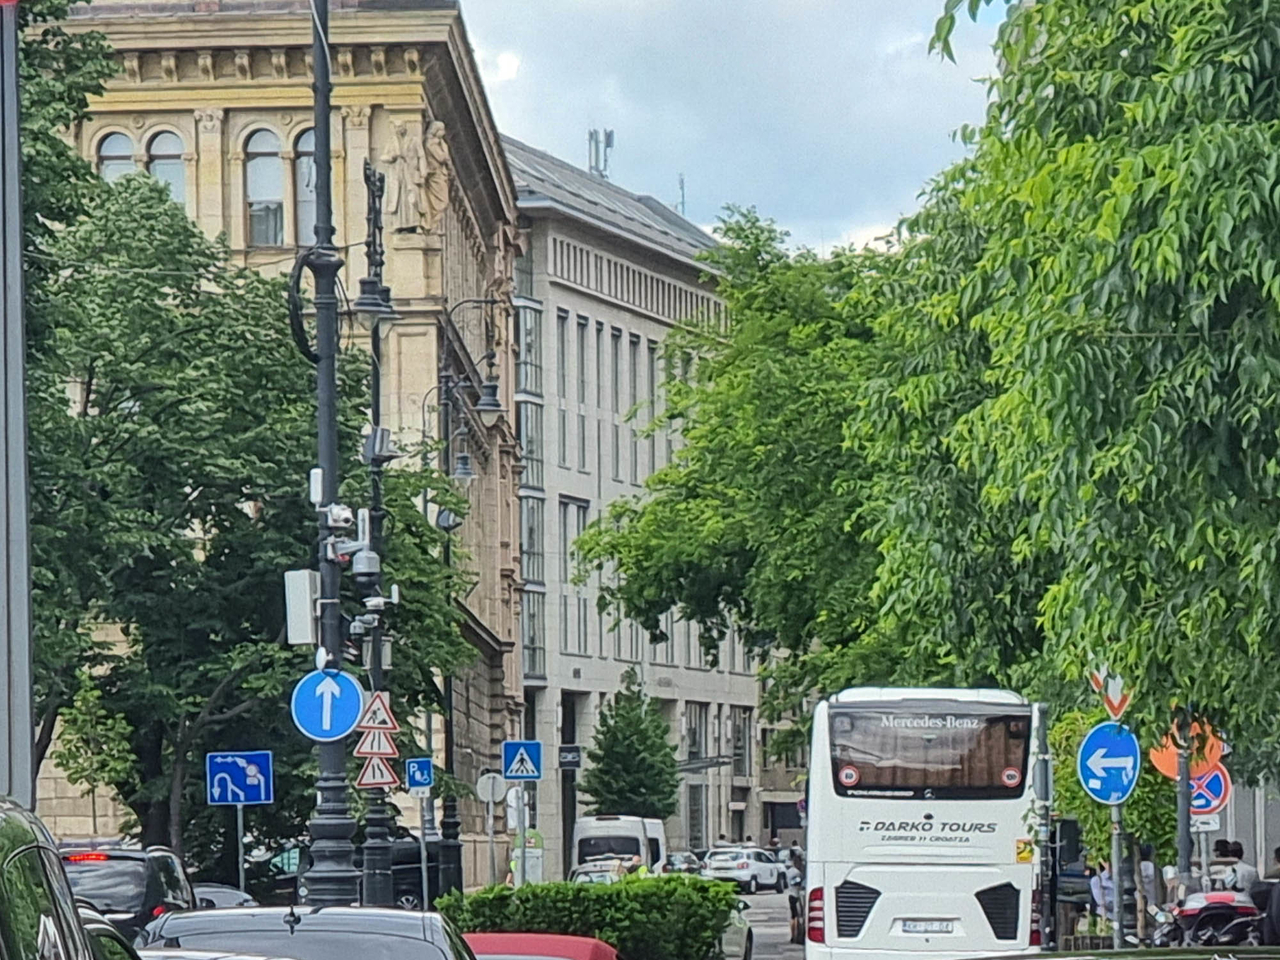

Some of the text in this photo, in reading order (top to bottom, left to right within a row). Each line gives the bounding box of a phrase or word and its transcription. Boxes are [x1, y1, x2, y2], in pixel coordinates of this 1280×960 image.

[881, 715, 979, 729] Mercedes-Benz
[873, 821, 998, 833] DARKO TOURS
